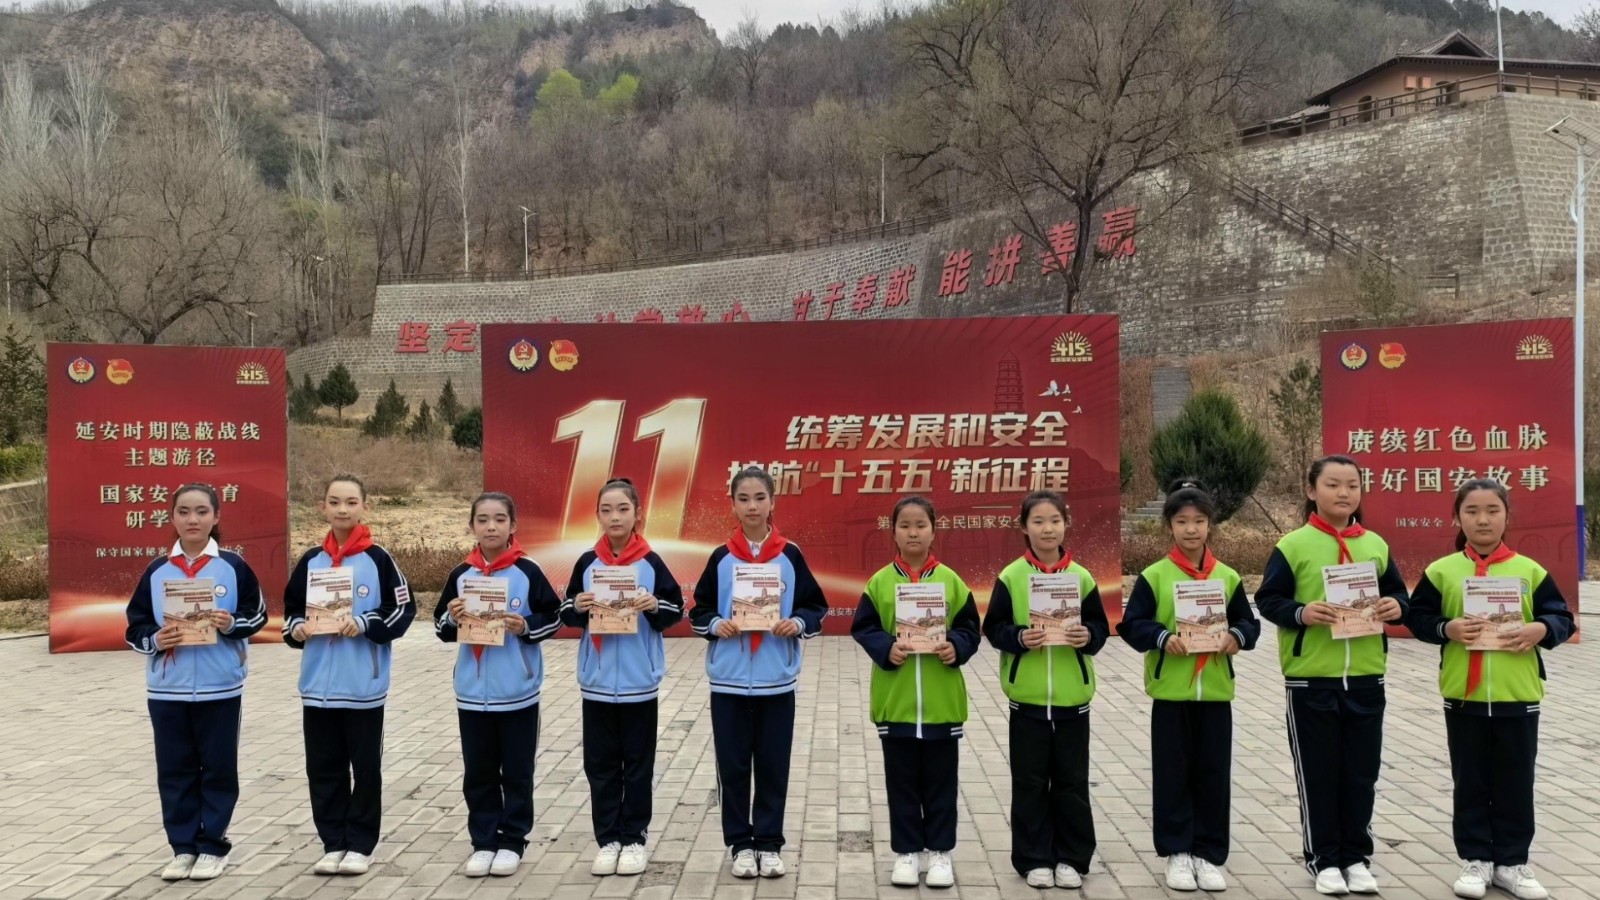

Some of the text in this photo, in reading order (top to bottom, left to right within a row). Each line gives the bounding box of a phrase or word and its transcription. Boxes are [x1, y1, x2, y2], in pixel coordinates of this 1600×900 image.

[793, 263, 916, 320] 甘于奉献
[938, 206, 1140, 297] 能拼善赢
[1056, 342, 1085, 356] 415
[1521, 343, 1548, 355] 415
[240, 370, 263, 380] 415
[75, 421, 261, 441] 延安时期隐蔽战线
[785, 410, 1070, 451] 统筹发展和安全
[1347, 423, 1549, 454] 赓续红色血脉
[124, 447, 216, 467] 主题游径
[552, 398, 707, 541] 11
[100, 483, 239, 504] 国家安育
